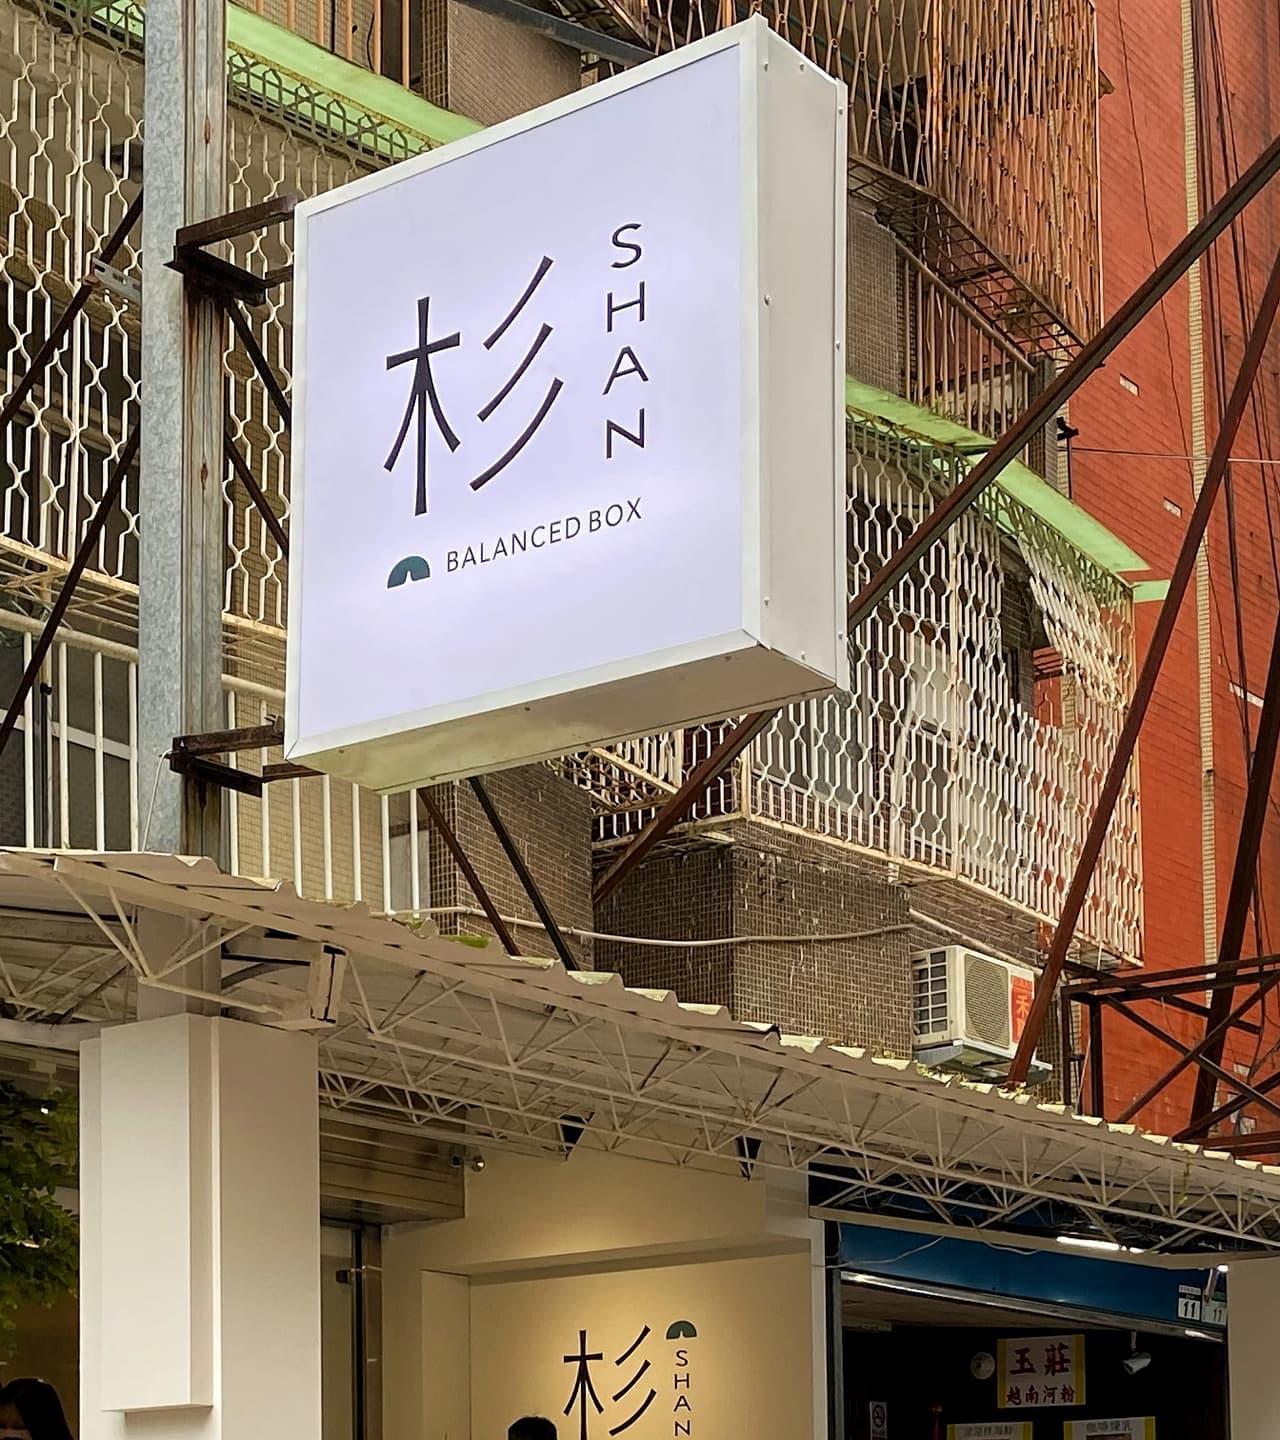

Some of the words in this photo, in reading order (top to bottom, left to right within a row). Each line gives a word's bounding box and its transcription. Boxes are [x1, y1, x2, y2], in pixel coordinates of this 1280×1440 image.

[603, 222, 650, 460] SHAN
[383, 255, 563, 517] 杉
[446, 517, 582, 574] BALANCED
[588, 497, 644, 534] BOX
[673, 1349, 692, 1437] SHAN
[1006, 1384, 1076, 1406] 越南河粉
[1009, 1342, 1071, 1377] 玉莊
